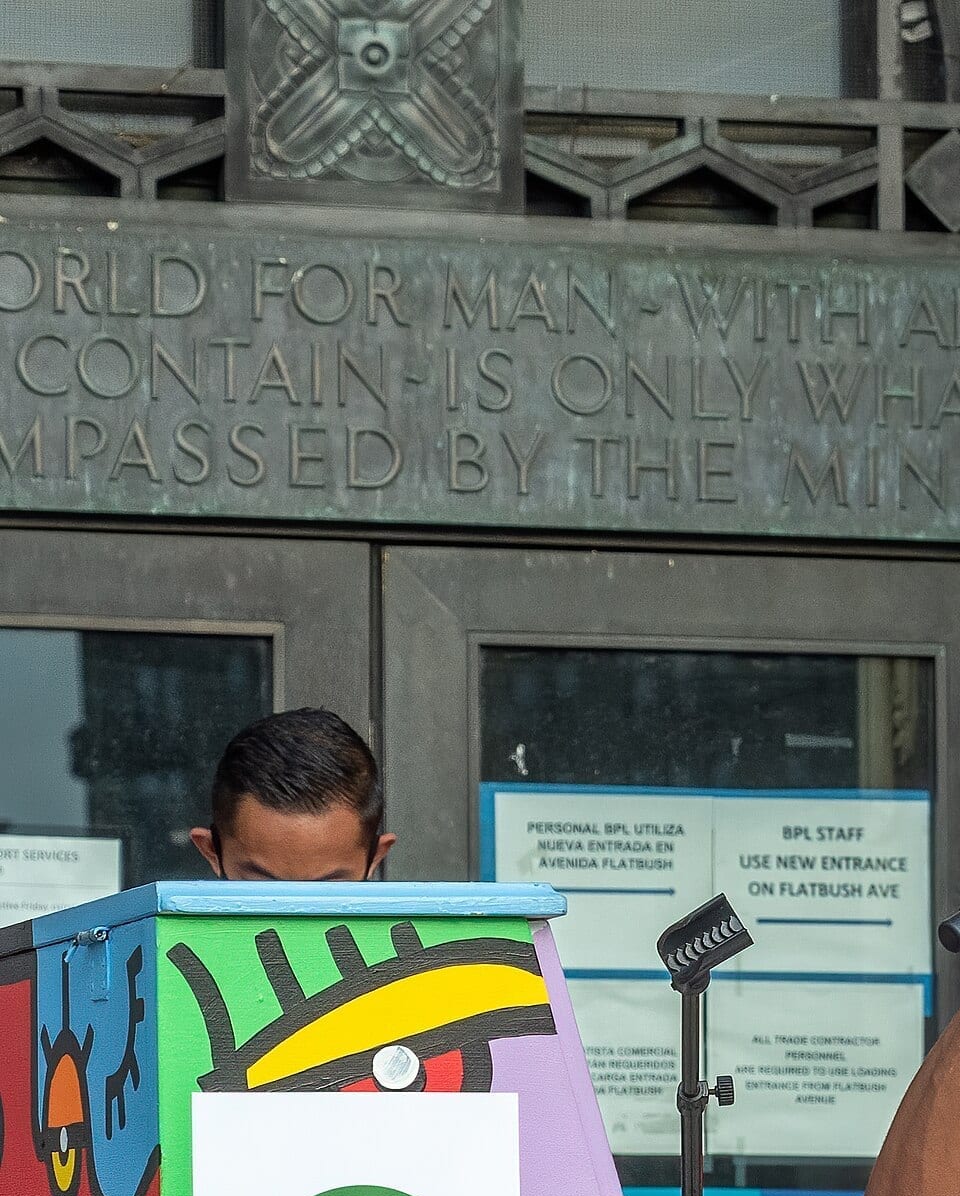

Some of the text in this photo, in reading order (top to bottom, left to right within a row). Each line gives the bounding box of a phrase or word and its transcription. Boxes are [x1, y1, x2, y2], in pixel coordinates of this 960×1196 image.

[251, 257, 411, 328] FOR
[444, 263, 618, 338] MAN
[672, 272, 868, 345] WITH
[15, 335, 390, 409] CONTAIN
[447, 348, 513, 413] IS
[551, 350, 770, 421] ONLY
[449, 426, 547, 496] BY
[573, 435, 736, 502] THE
[527, 821, 685, 836] PERSONAL BPL UTILIZA
[782, 825, 865, 841] BPL STAFF
[538, 839, 674, 853] NUEVA ENTRADA EN
[22, 849, 79, 862] SERVICES
[539, 856, 673, 870] AVENIDA FLATBUSH
[739, 854, 908, 872] USE NEW ENTRANCE
[748, 881, 900, 899] ON FLATBUSH AVE
[752, 1034, 881, 1046] ALL TRADE CONTRACTOR
[616, 1046, 678, 1056] COMERCIAL
[785, 1051, 846, 1061] PERSONNEL
[608, 1060, 675, 1069] REQUERIDOS
[629, 1072, 677, 1082] ENTRADA
[735, 1065, 897, 1078] ARE REQUIRED TO USE LOADING
[608, 1086, 663, 1095] FLATBUSH
[745, 1081, 887, 1092] ENTRANCE FROM FLATBUSH
[795, 1095, 836, 1105] AVENUE
